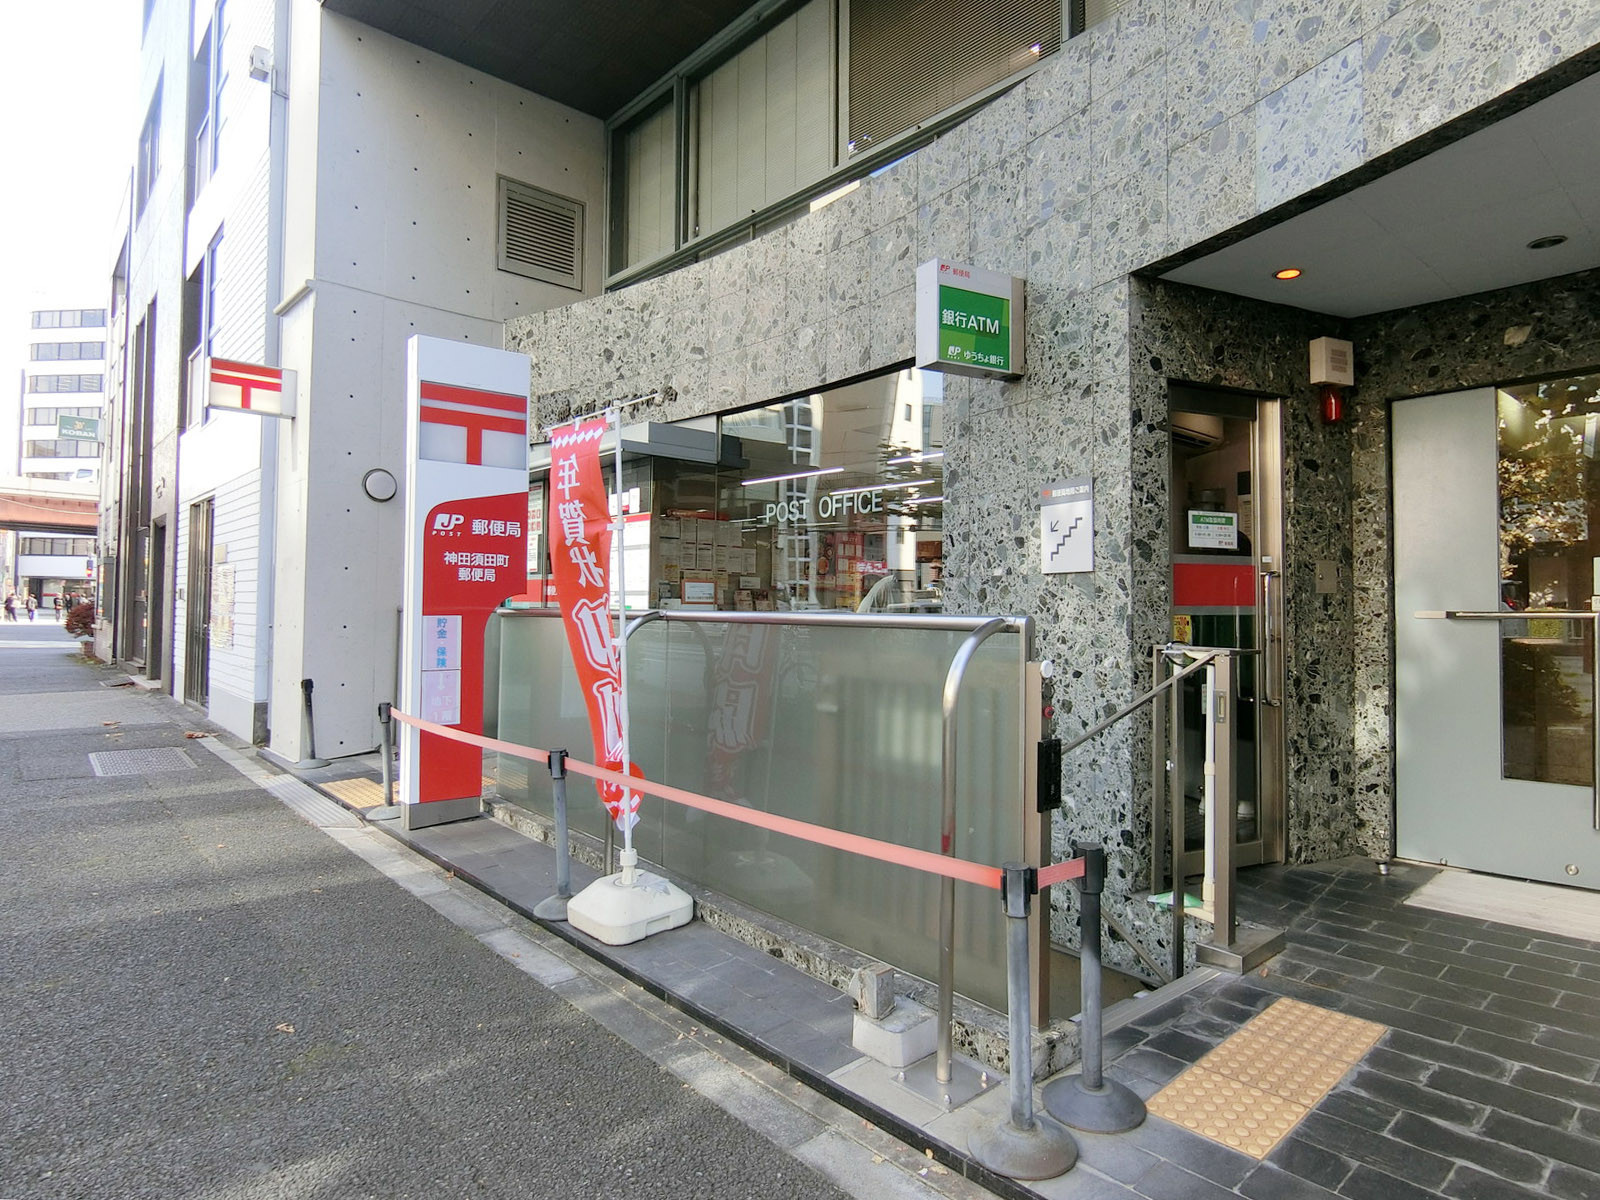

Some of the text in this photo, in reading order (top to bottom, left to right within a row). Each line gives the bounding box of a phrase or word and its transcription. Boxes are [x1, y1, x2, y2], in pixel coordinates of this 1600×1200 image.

[942, 309, 999, 335] 銀行ATM
[964, 351, 1004, 366] ゆうちょ銀行
[766, 490, 883, 523] POST OFFICE
[472, 519, 521, 538] 郵便局
[443, 551, 509, 567] 神田須田町
[458, 567, 496, 582] 郵便局
